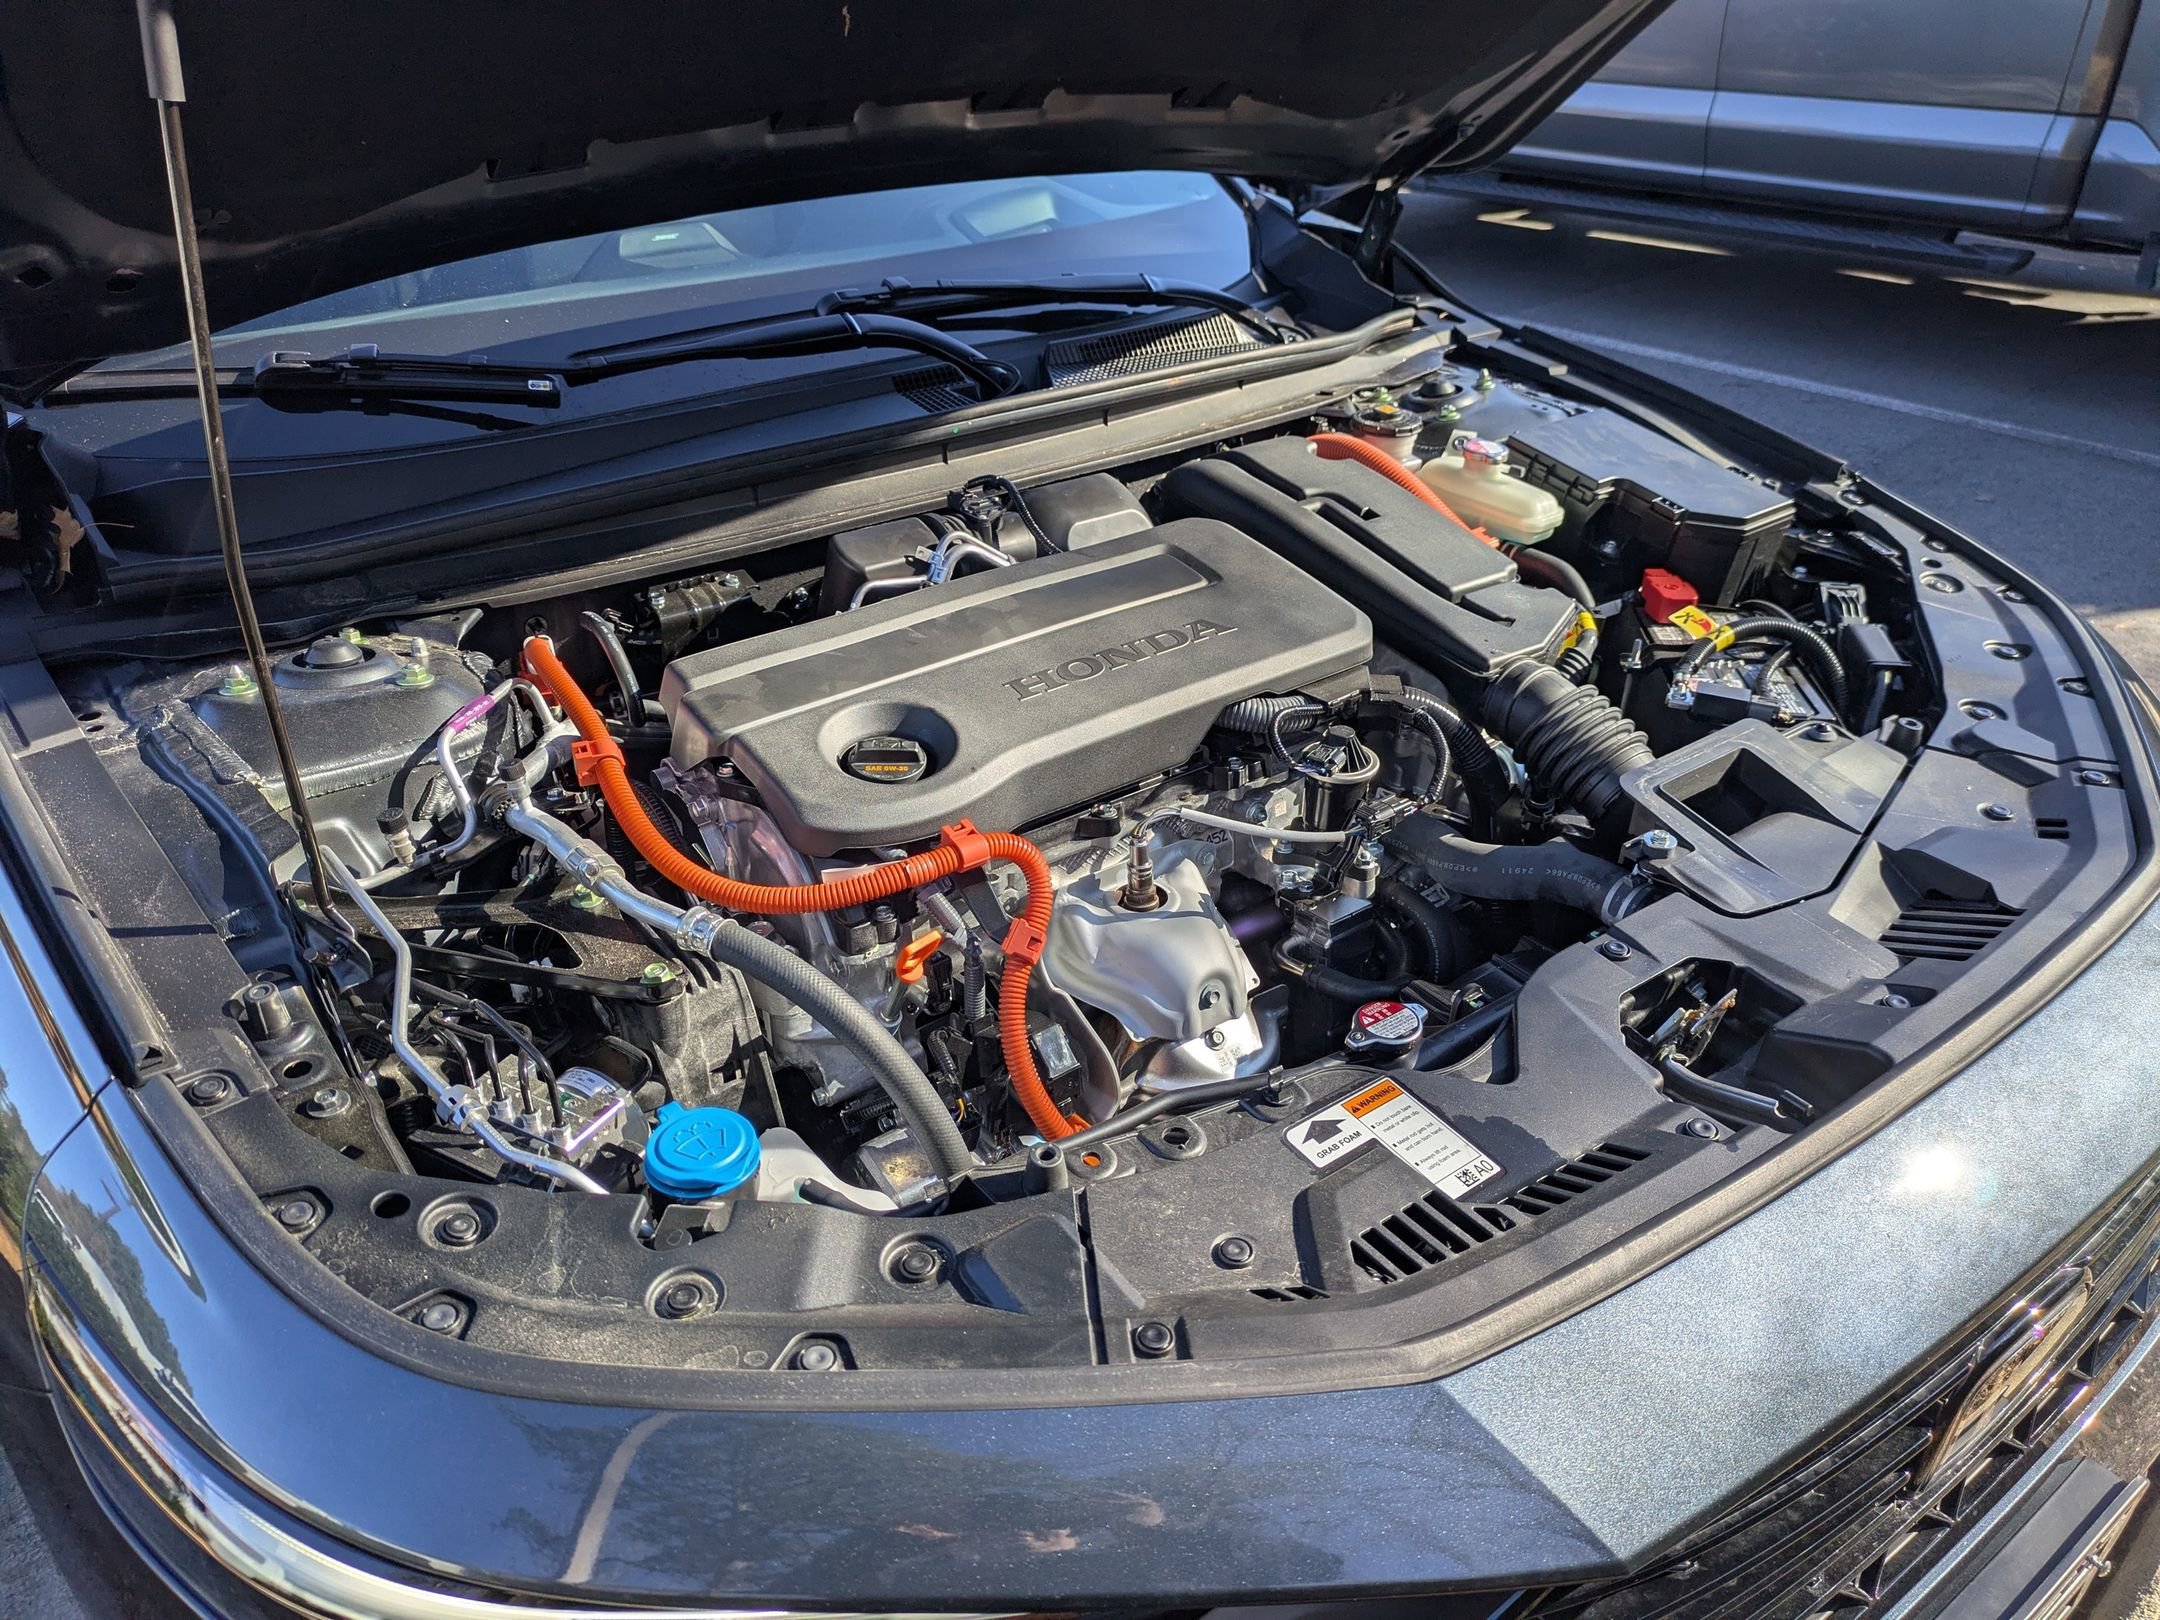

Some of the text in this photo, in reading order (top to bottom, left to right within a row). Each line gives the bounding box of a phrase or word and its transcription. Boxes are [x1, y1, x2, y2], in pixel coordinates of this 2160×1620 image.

[1002, 618, 1239, 701] HONDA
[1359, 1085, 1396, 1108] WARNING
[1316, 1130, 1362, 1158] GRAB FOAM
